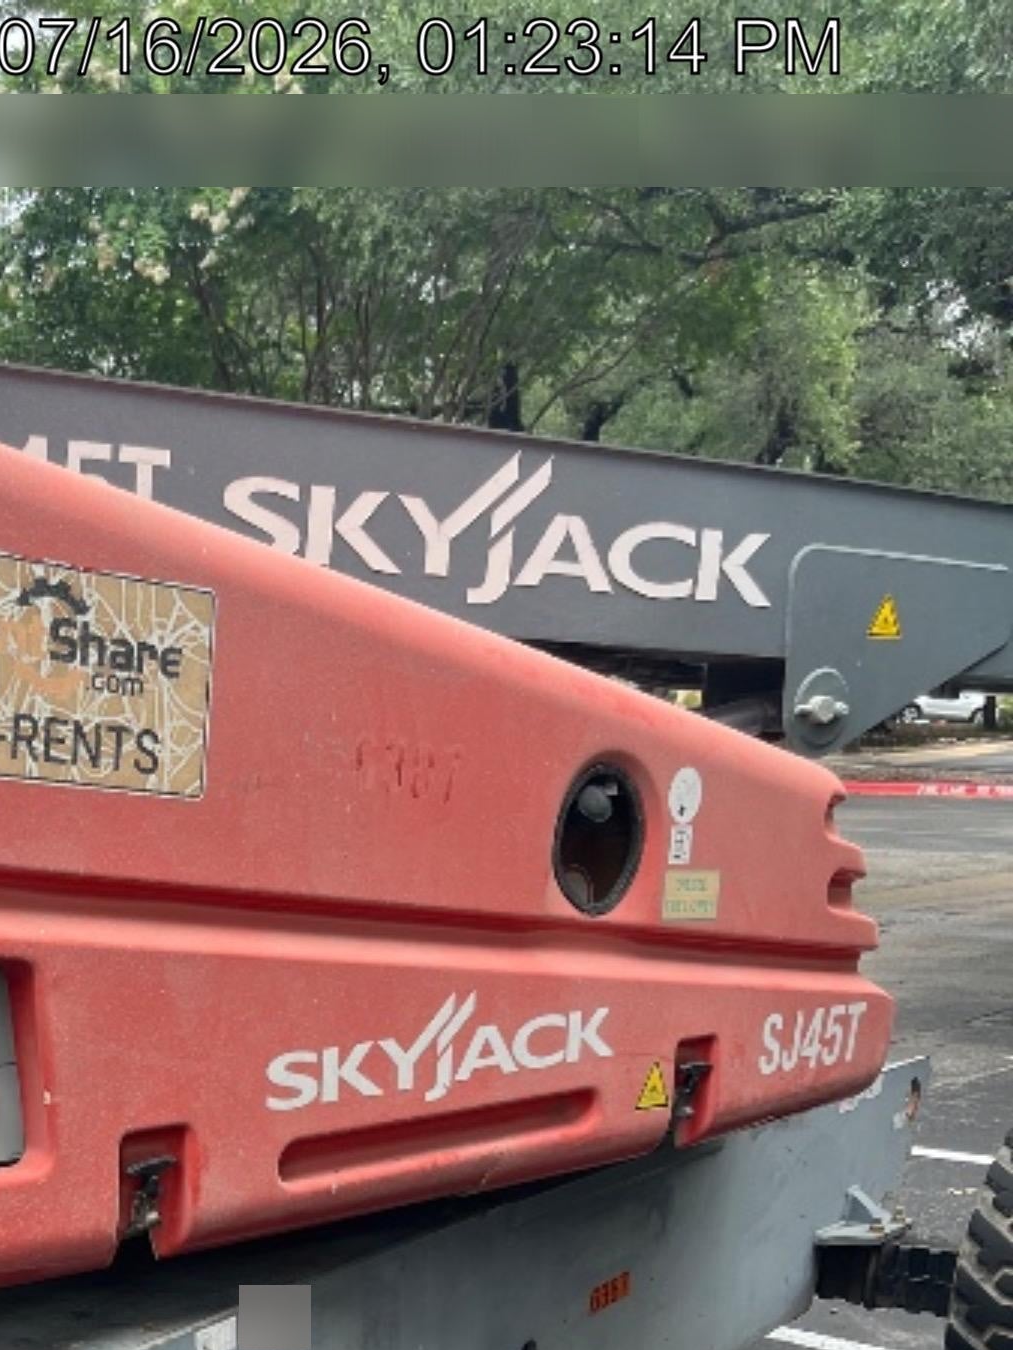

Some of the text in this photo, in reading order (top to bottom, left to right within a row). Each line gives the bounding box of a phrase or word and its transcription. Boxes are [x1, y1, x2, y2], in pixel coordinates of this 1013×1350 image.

[223, 449, 771, 607] SKYJACK
[49, 616, 183, 679] Share
[265, 989, 615, 1111] SKYJACK
[757, 1001, 868, 1076] SJ45T
